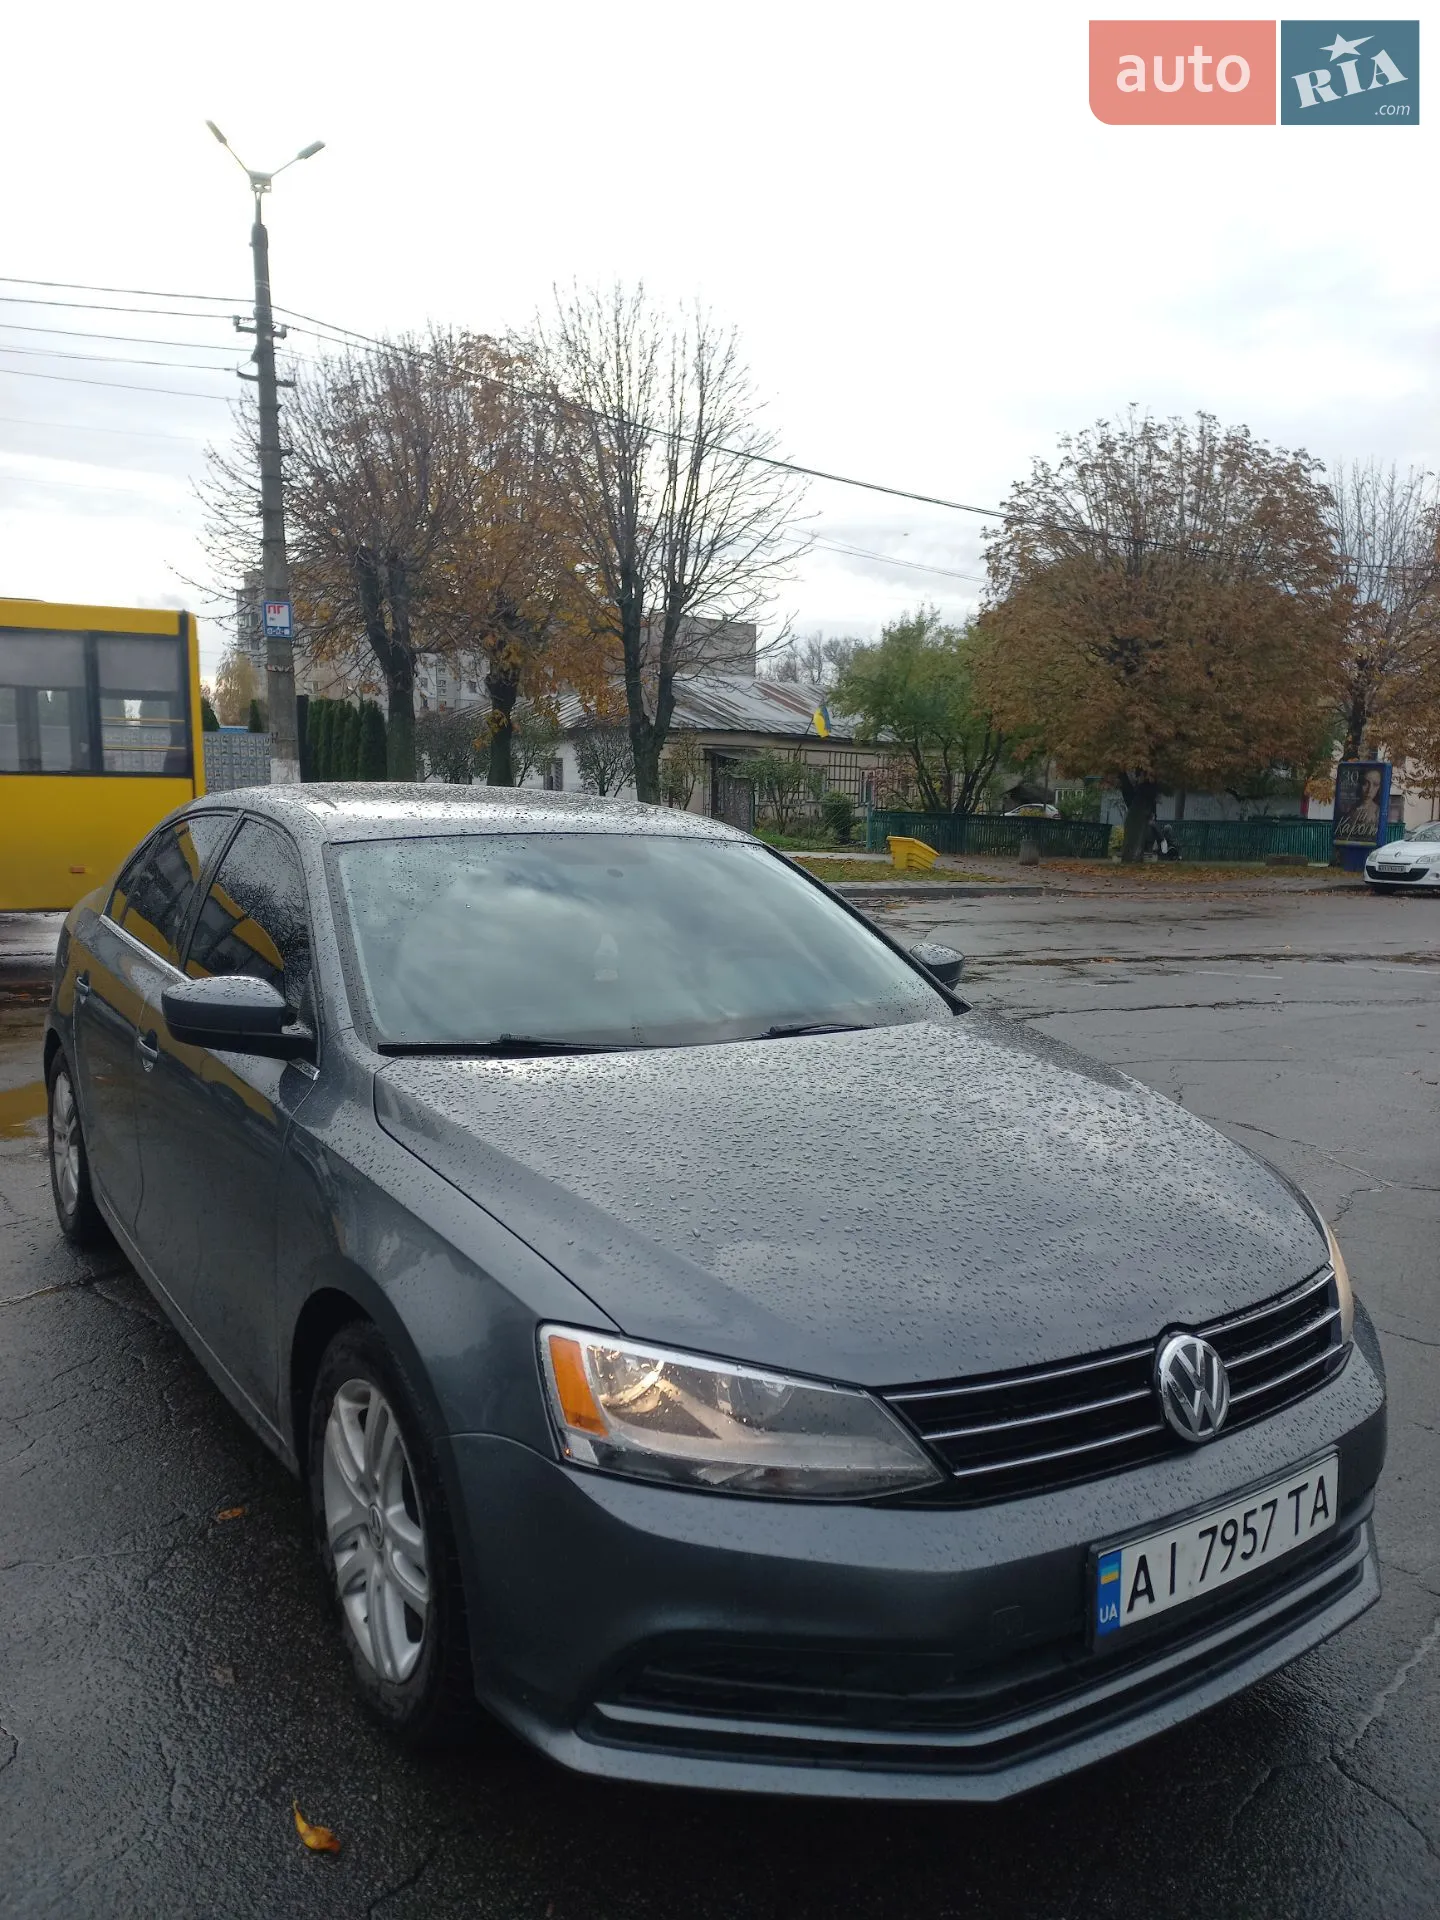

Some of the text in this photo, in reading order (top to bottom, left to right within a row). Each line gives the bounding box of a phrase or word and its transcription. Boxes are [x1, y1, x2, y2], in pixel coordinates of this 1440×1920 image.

[1198, 1497, 1279, 1583] 7957
[1287, 1475, 1330, 1537] TA
[1099, 1603, 1119, 1624] UA
